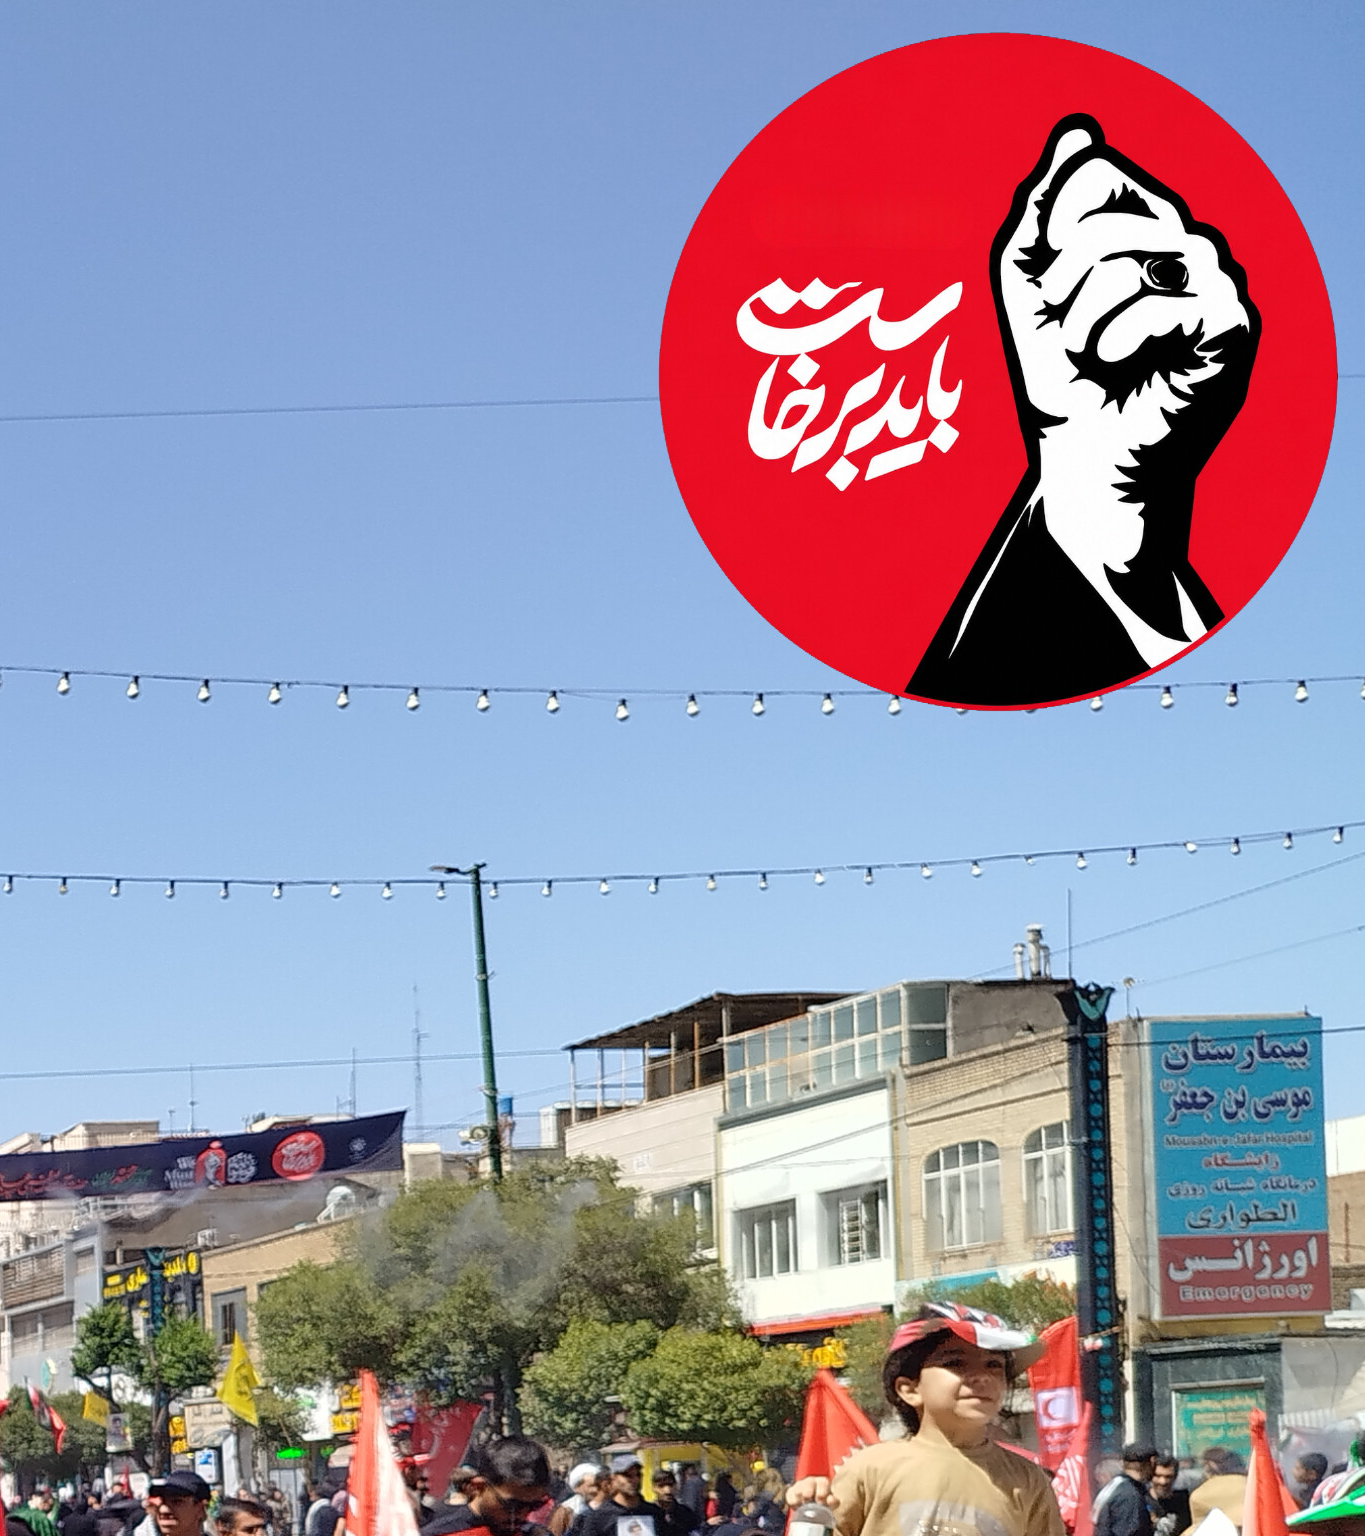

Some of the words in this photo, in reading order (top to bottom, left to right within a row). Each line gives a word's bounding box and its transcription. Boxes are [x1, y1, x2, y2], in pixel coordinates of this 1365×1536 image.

[1161, 1031, 1310, 1074] بیمارستان
[1164, 1078, 1217, 1125] جعفر
[1221, 1085, 1247, 1121] بن
[1251, 1087, 1313, 1121] موسی
[1202, 1152, 1281, 1173] زایشگاه
[1168, 1181, 1207, 1199] روزی
[1211, 1177, 1255, 1196] شبانه
[1261, 1175, 1317, 1193] درمانگاه
[1168, 1236, 1318, 1282] اورژانس
[1179, 1283, 1314, 1302] Emergency
